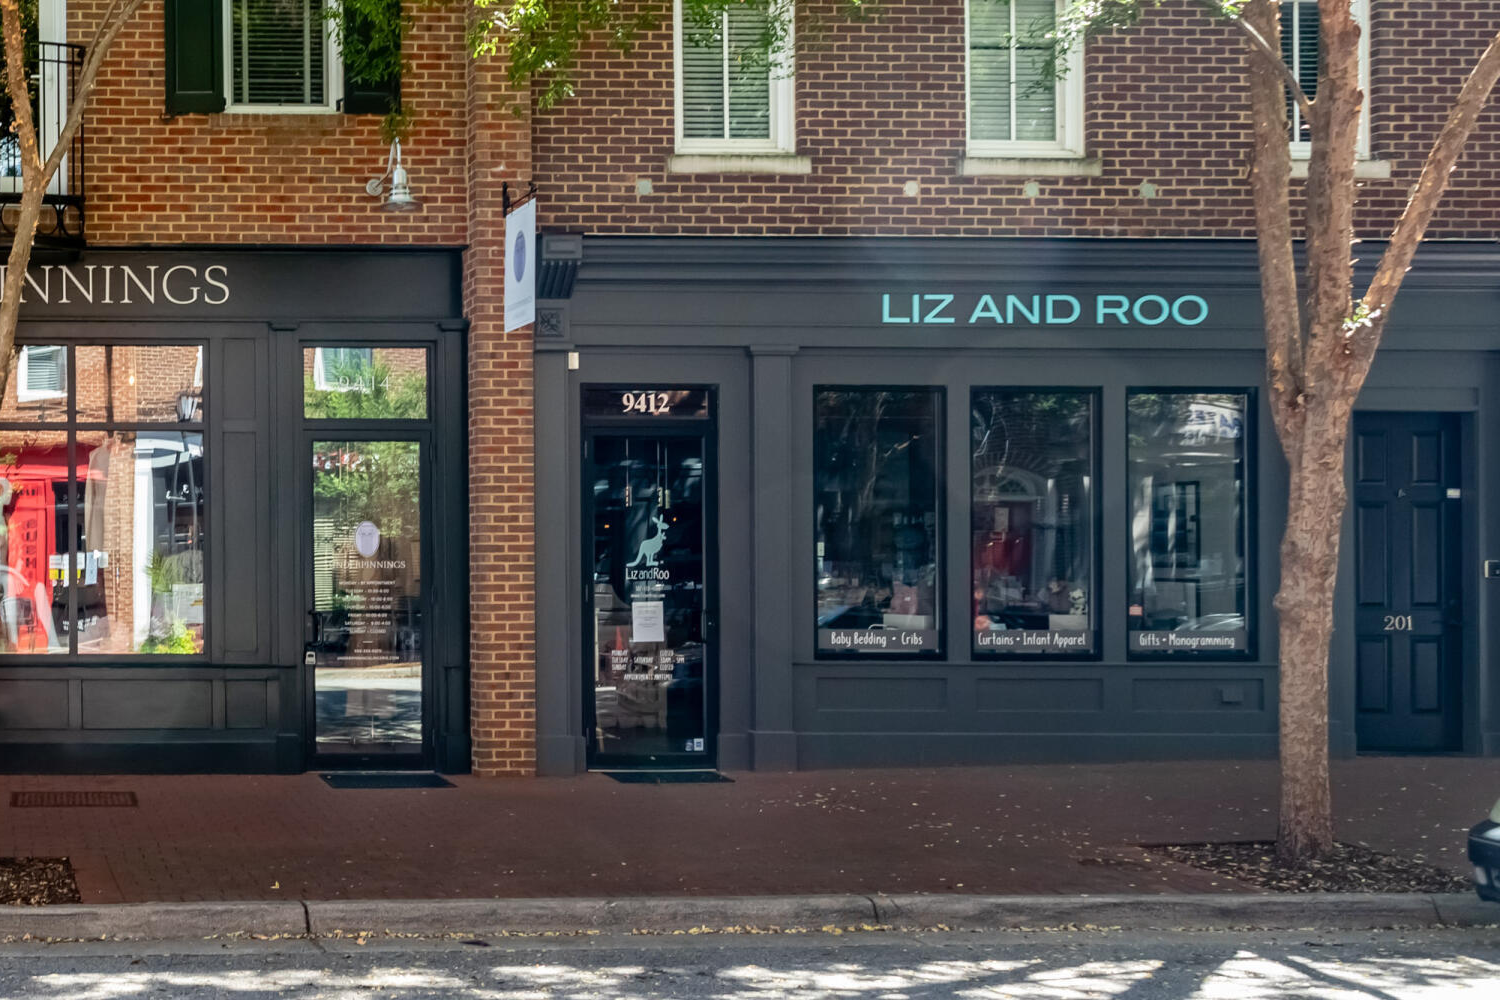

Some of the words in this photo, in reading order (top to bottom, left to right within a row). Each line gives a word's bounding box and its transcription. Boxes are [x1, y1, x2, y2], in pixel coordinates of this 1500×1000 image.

[881, 293, 955, 324] LIZ
[968, 294, 1081, 325] AND
[1096, 294, 1210, 326] ROO
[622, 392, 670, 413] 9412
[1384, 615, 1413, 631] 201
[831, 631, 852, 648] Baby
[853, 631, 887, 648] Bedding
[901, 631, 923, 645] Cribs
[978, 632, 1014, 645] Curtains
[1022, 632, 1051, 645] Infant
[1053, 632, 1086, 648] Apparel
[1139, 633, 1160, 646] Gifts
[1168, 633, 1235, 649] Monogramming
